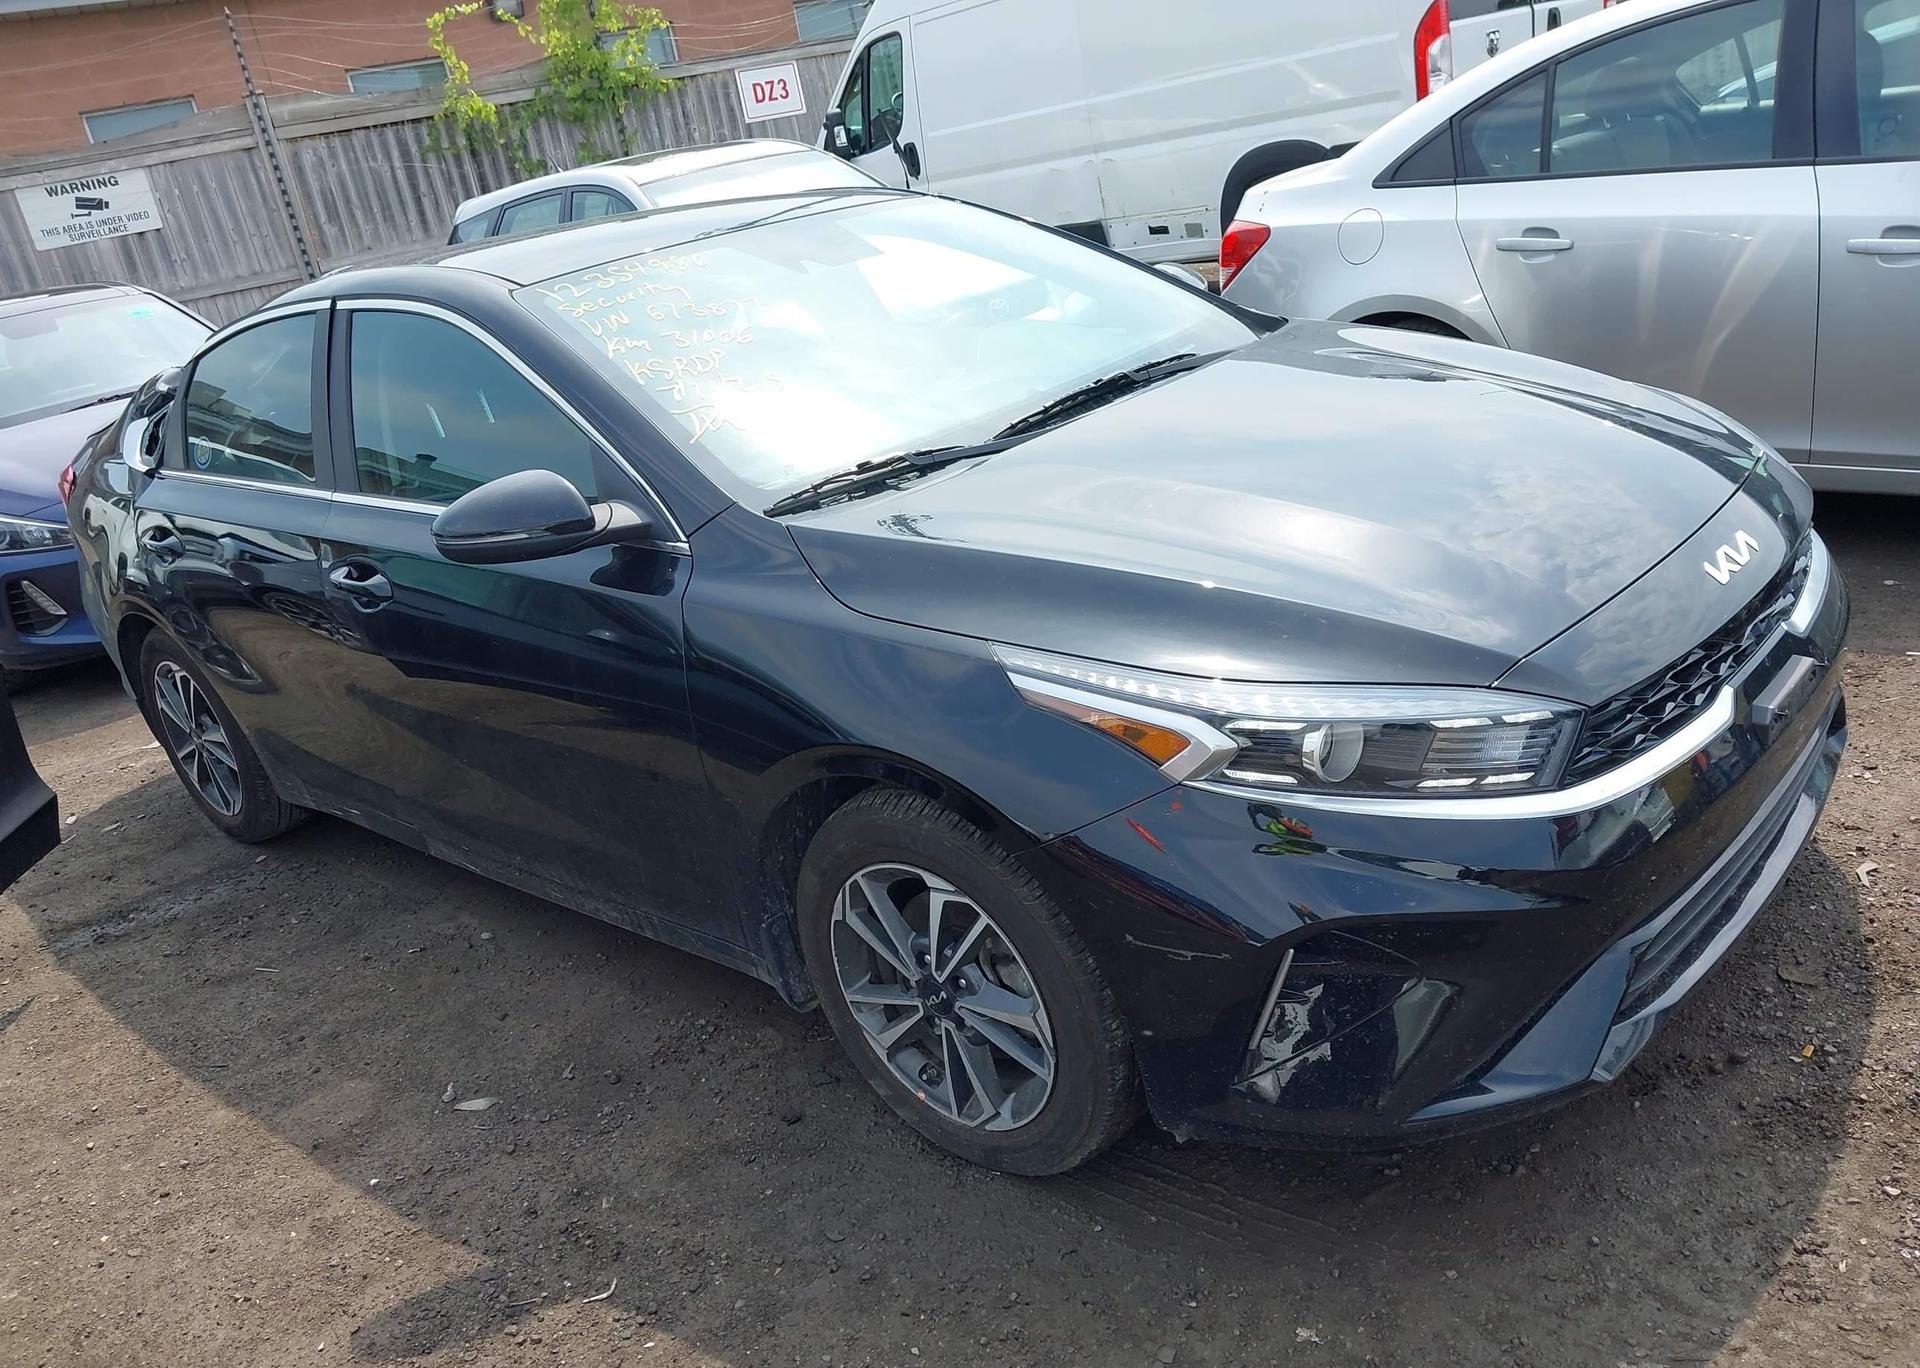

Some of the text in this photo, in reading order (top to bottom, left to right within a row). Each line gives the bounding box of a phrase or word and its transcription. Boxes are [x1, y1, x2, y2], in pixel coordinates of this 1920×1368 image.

[752, 78, 789, 104] DZ3
[44, 175, 120, 197] WARNING
[40, 210, 150, 238] THIS AREA IS UNDER VIDEO
[69, 223, 129, 242] SURVEILLANCE
[578, 310, 630, 337] VIN
[1703, 529, 1759, 585] KIA
